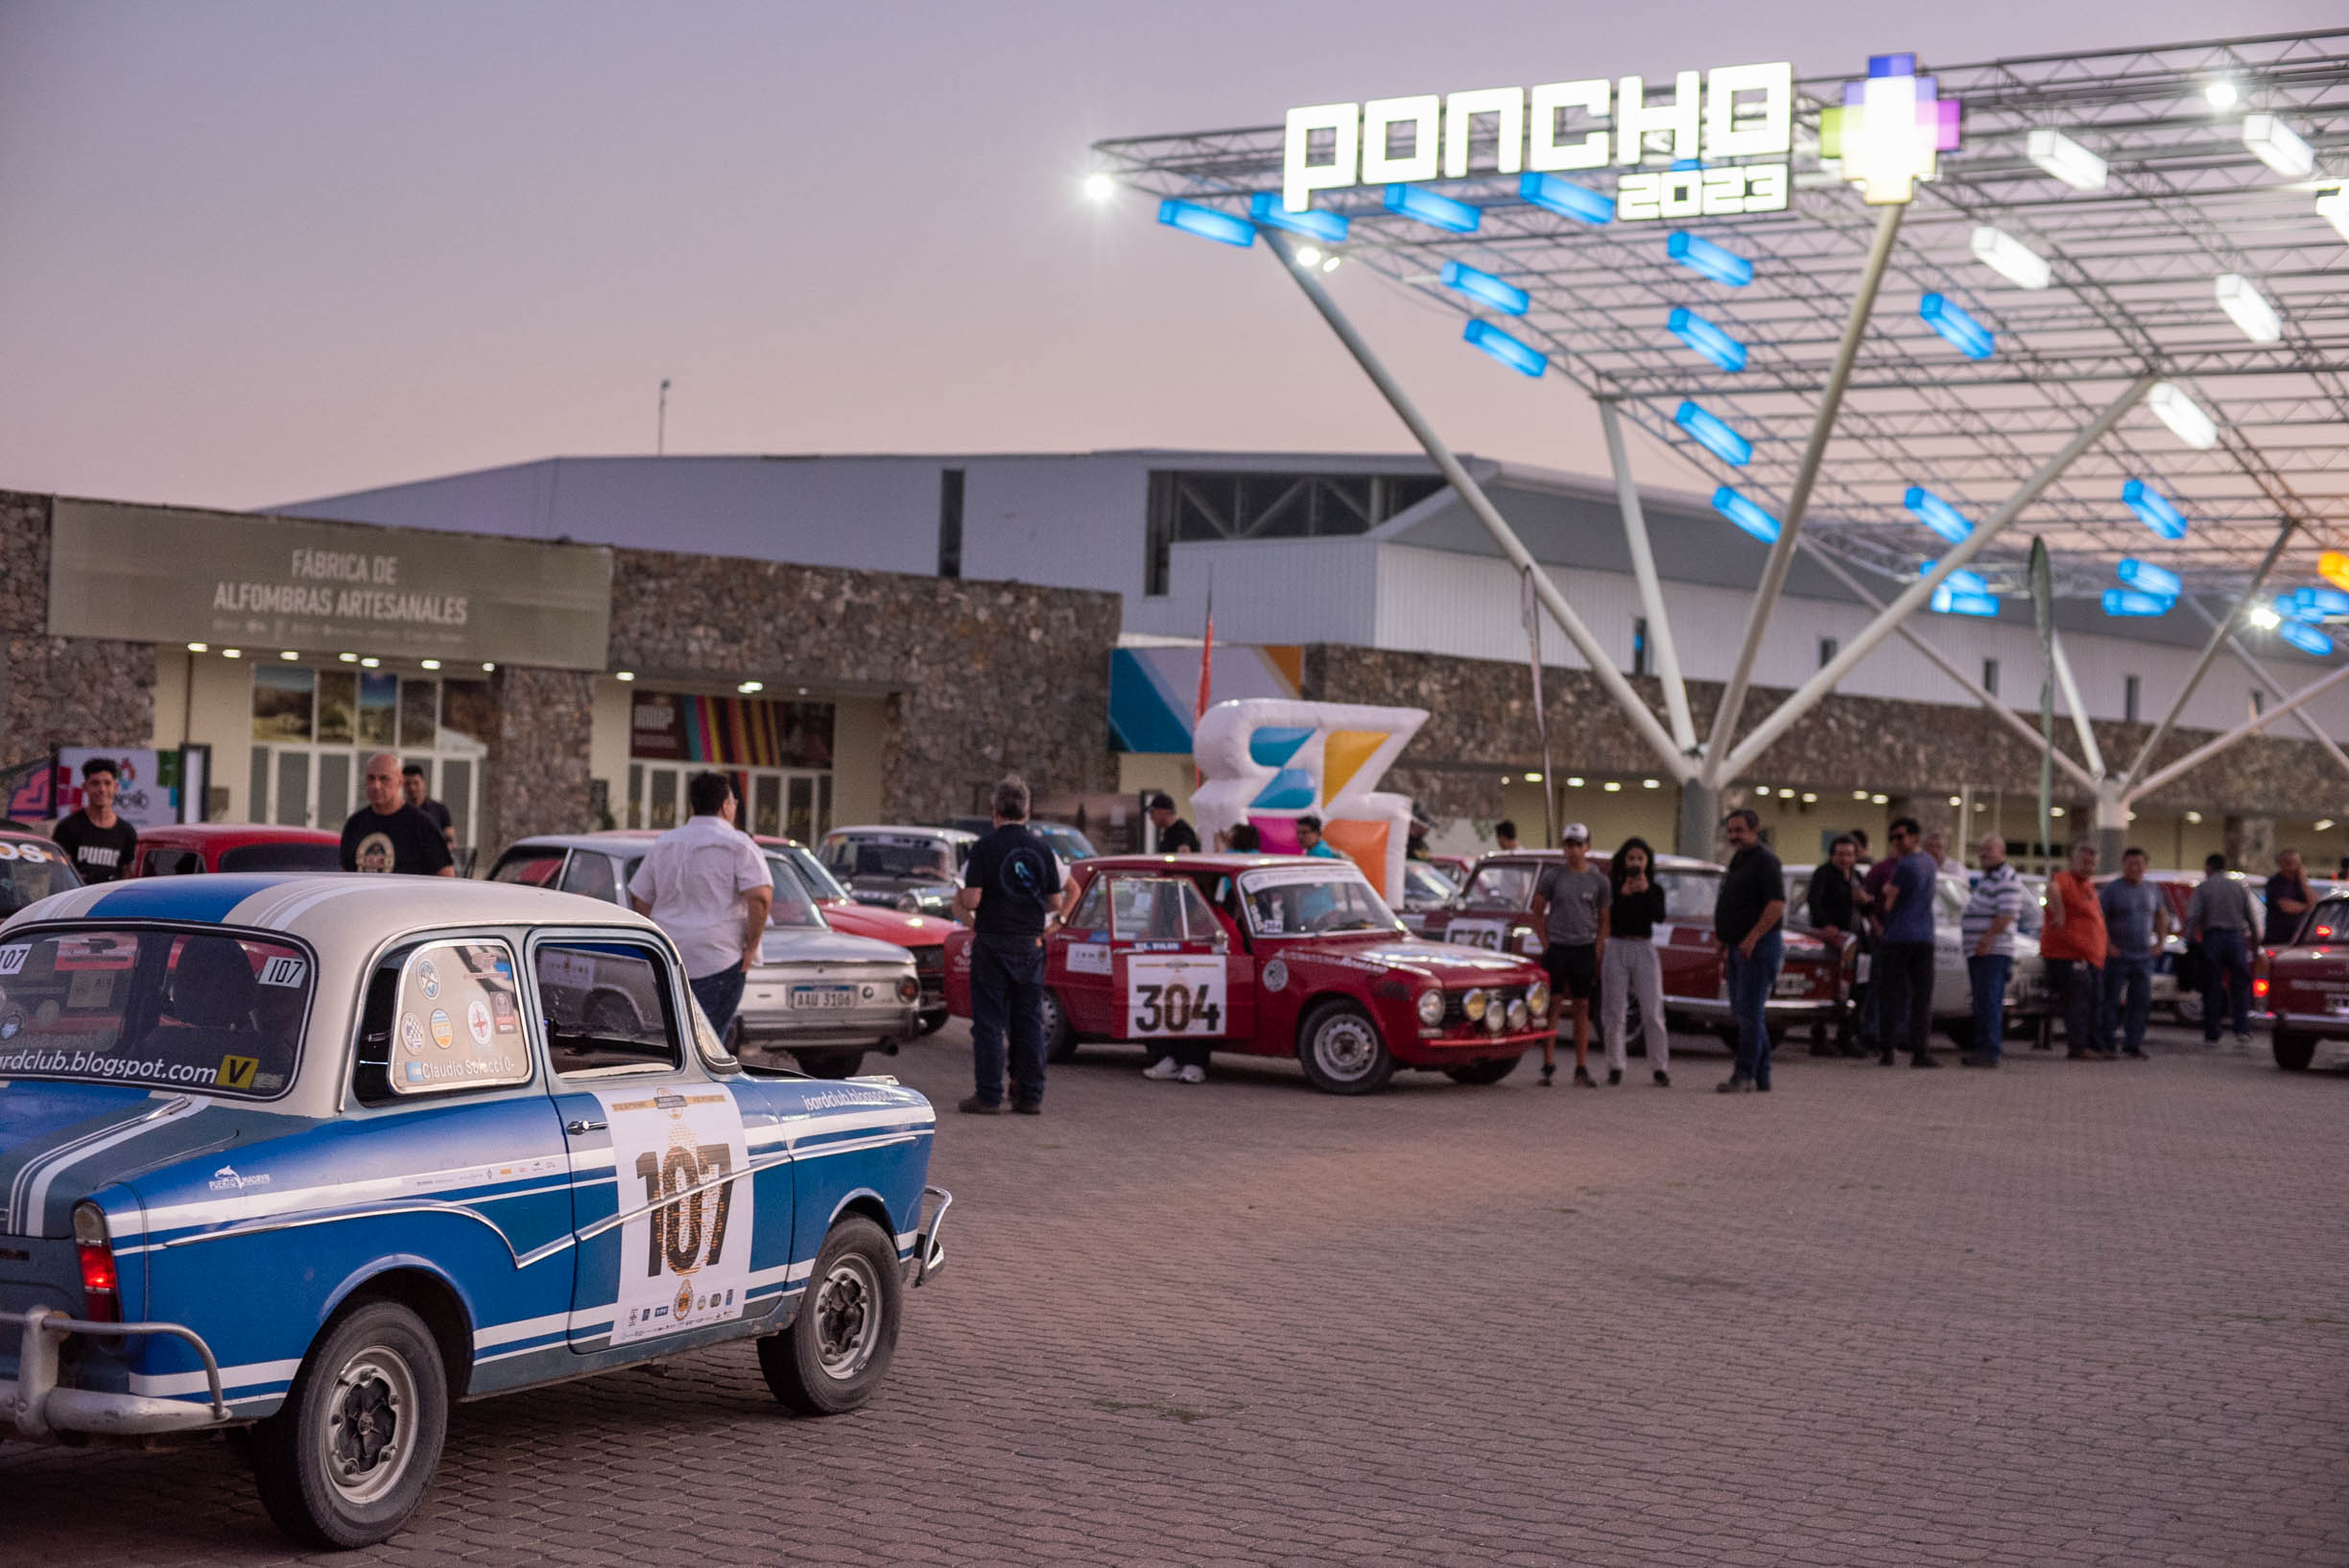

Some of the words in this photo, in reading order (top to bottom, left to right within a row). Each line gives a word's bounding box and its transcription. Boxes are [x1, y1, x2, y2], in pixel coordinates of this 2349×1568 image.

[1618, 163, 1788, 221] 2023
[291, 547, 369, 582] FÁBRICA
[372, 556, 399, 584] DE
[213, 582, 334, 617] ALFOMBRAS
[336, 590, 468, 624] ARTESANALES
[268, 961, 303, 984] 107
[1135, 984, 1221, 1032] 304
[0, 1050, 217, 1084] rdclub.blogspot.com
[227, 1058, 250, 1081] V
[422, 1059, 463, 1079] Claudio
[635, 1143, 735, 1277] 107
